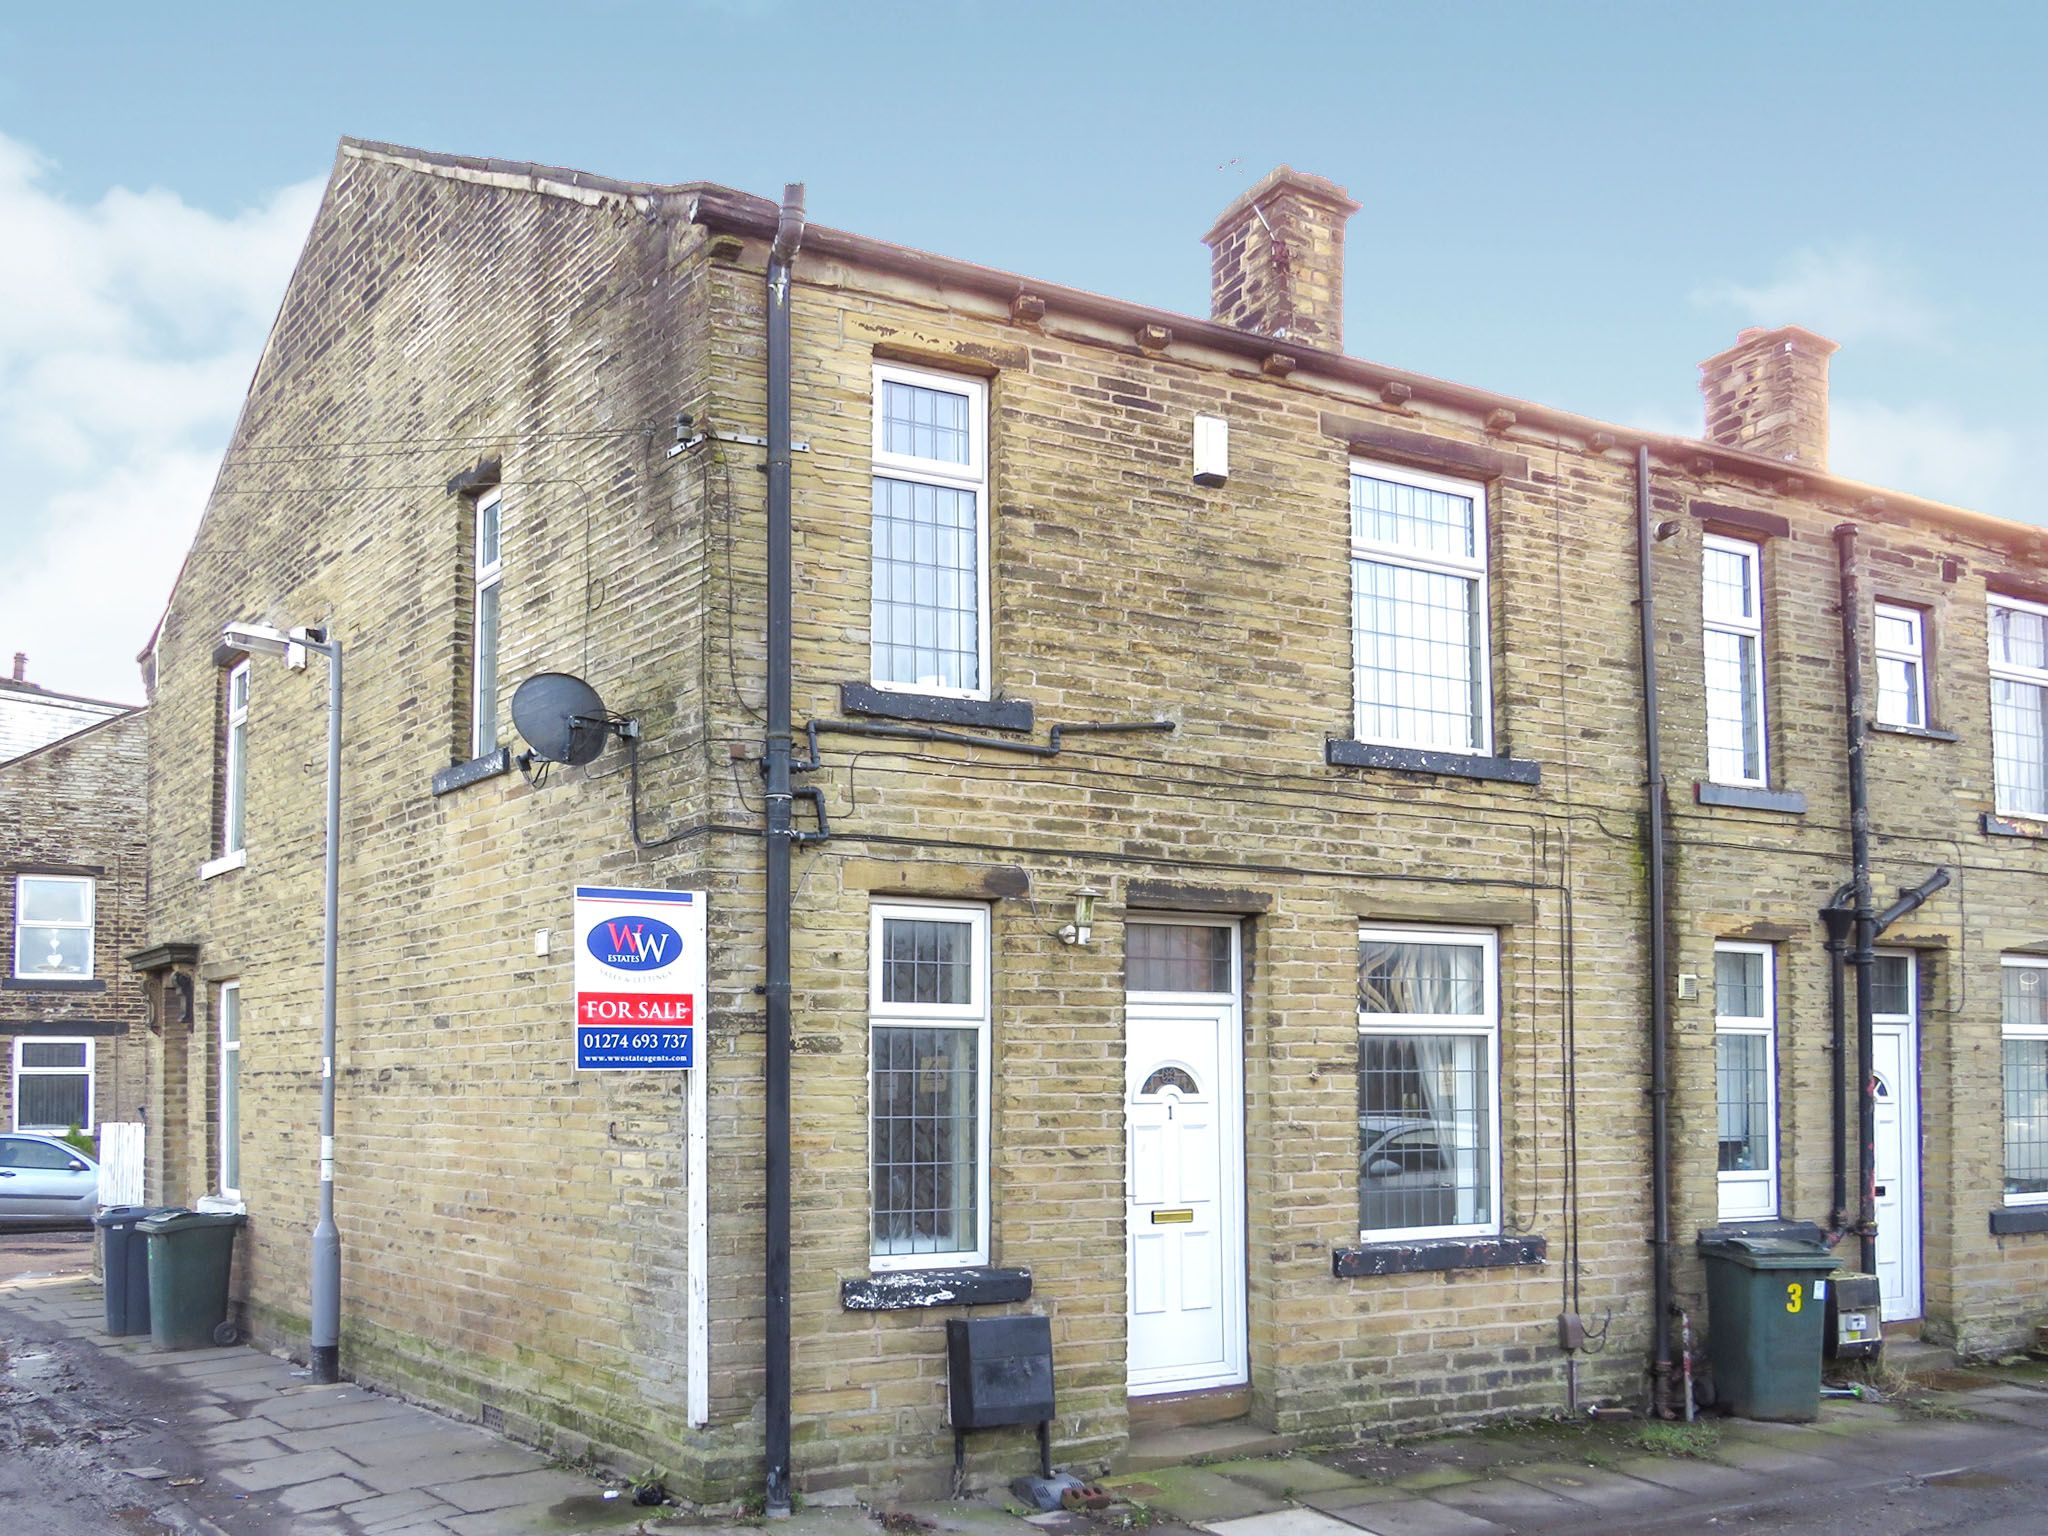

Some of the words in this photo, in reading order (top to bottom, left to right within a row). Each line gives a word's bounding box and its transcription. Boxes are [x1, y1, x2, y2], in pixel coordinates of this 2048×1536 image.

[608, 954, 640, 963] ESTATES
[587, 1000, 634, 1019] FOR
[638, 1001, 686, 1019] SALE
[584, 1033, 629, 1048] 01274
[632, 1034, 659, 1049] 693
[662, 1034, 688, 1049] 737
[584, 1055, 687, 1063] www.wwestateagents.com
[1786, 1283, 1803, 1313] 3
